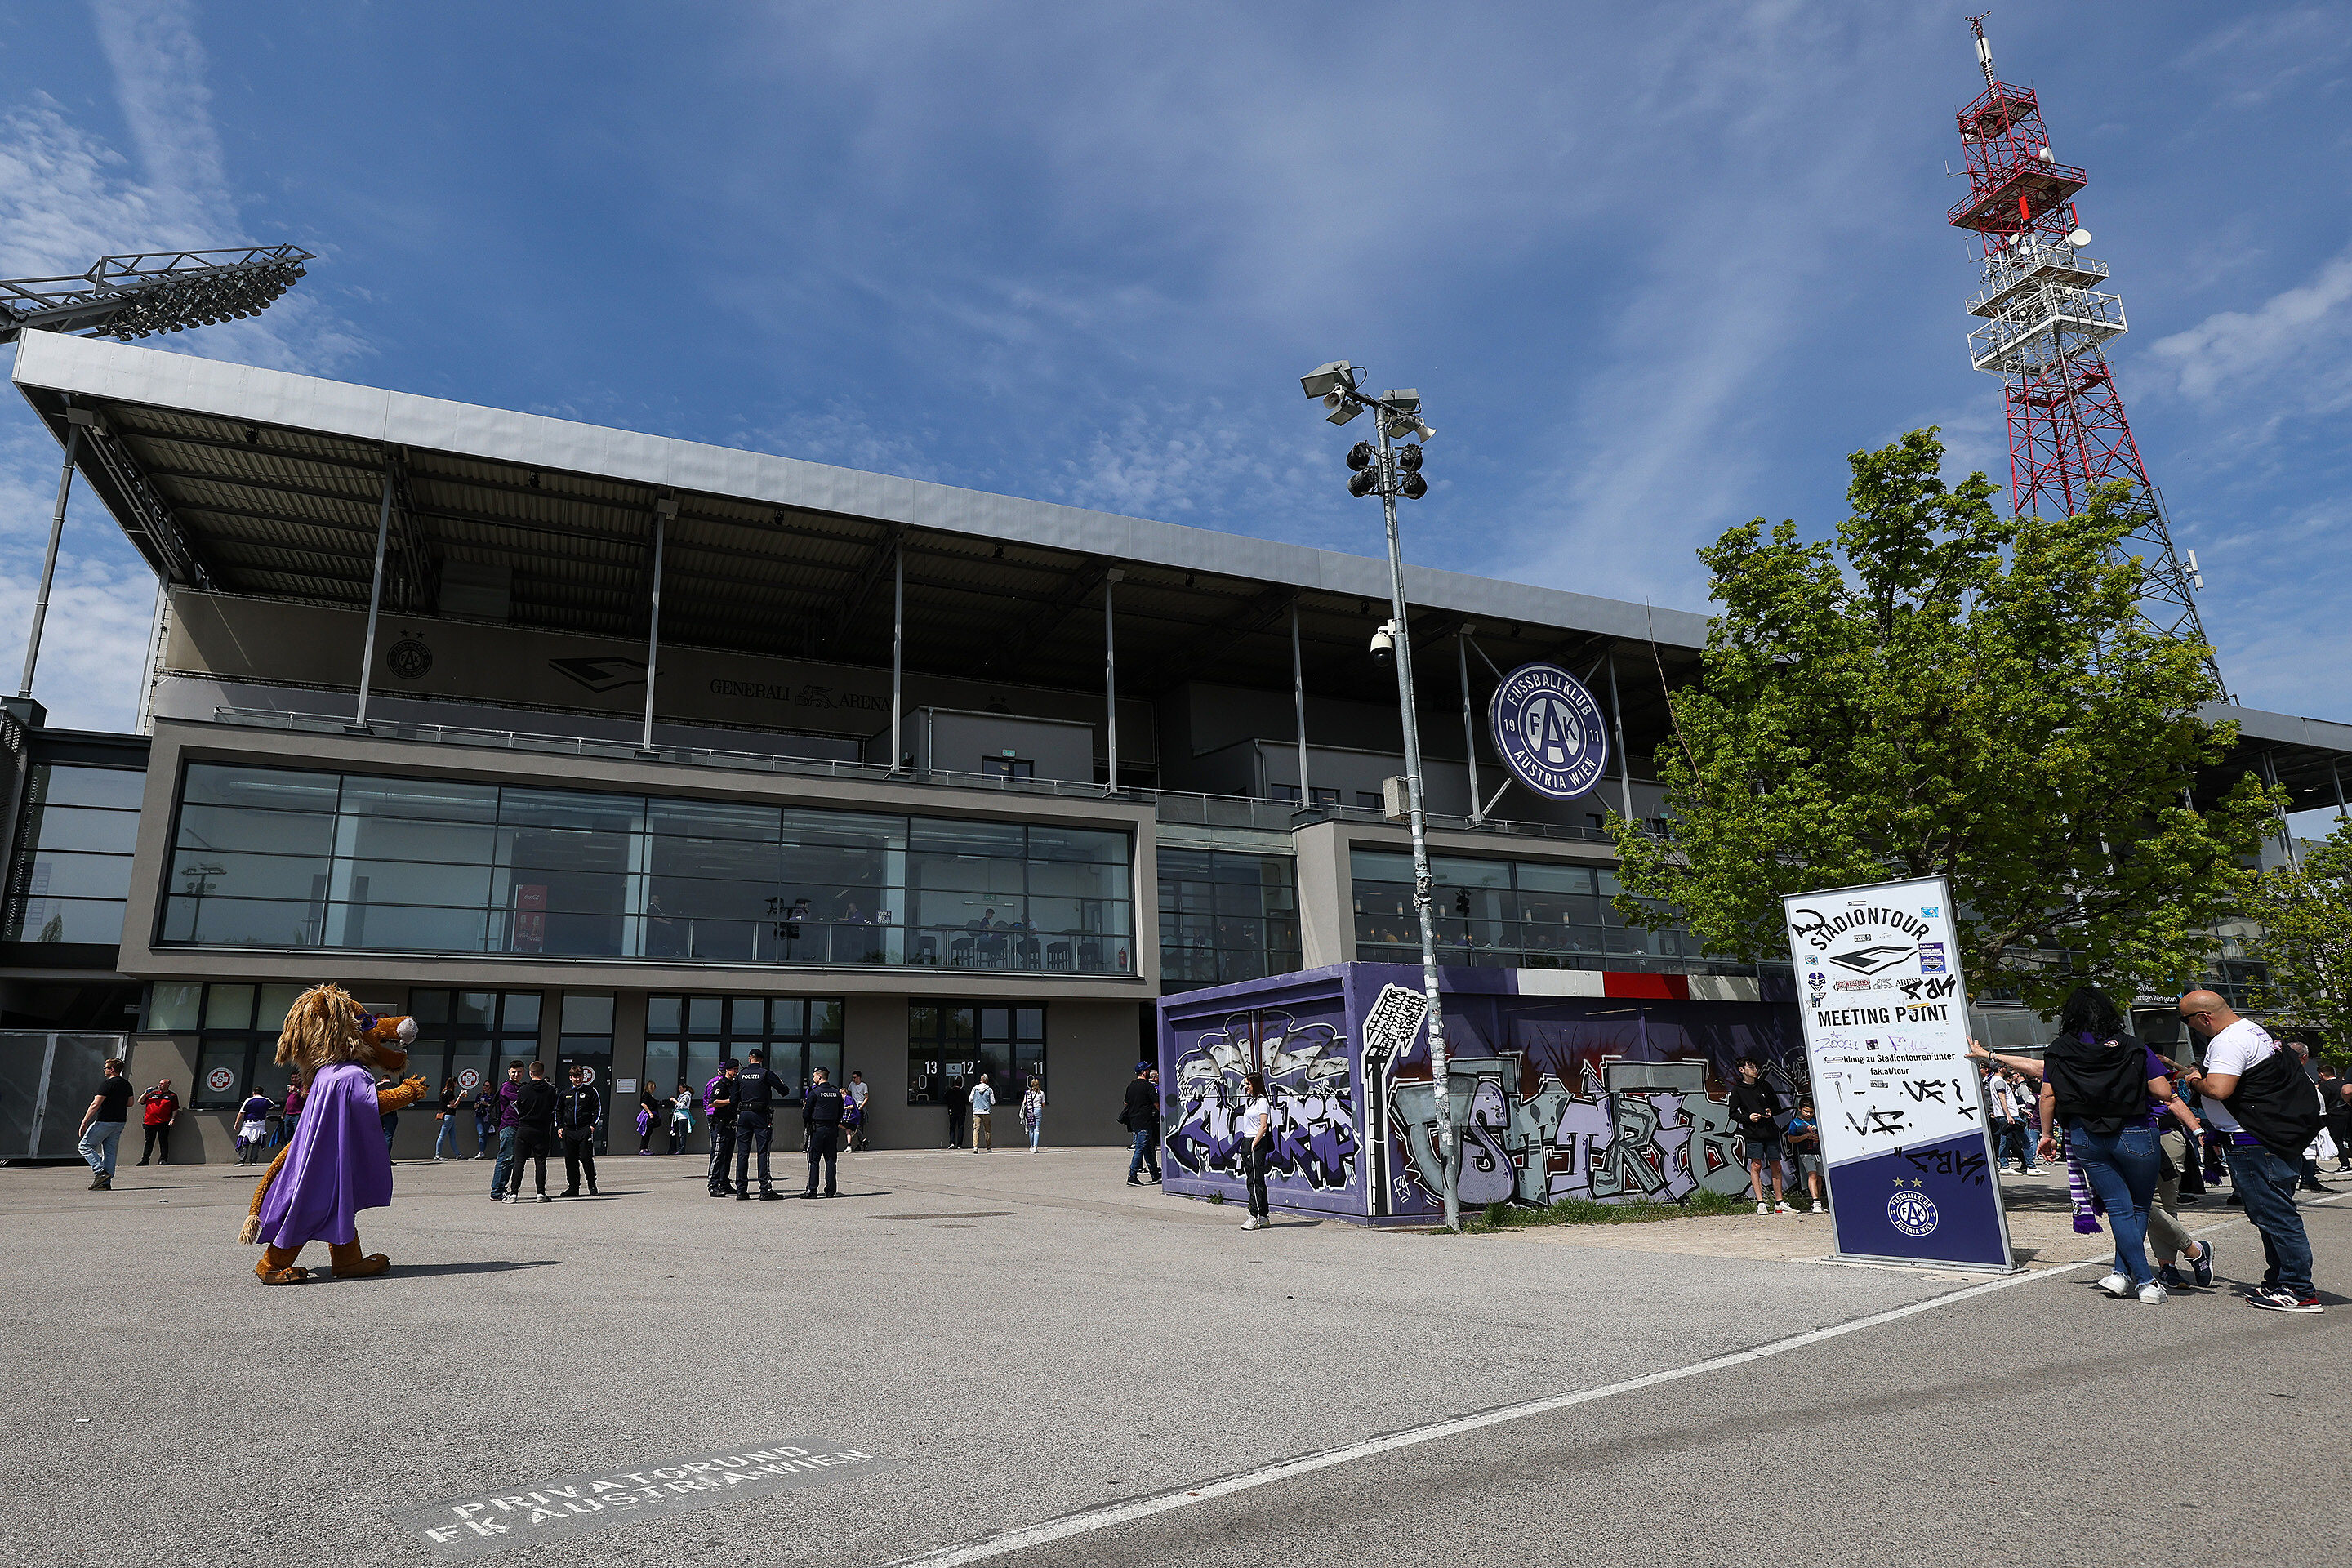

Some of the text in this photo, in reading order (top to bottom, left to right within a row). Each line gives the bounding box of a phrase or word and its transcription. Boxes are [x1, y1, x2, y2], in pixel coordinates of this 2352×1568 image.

[710, 679, 892, 711] GENERALI ARENA
[1506, 673, 1592, 715] FUSSBALLKLUB
[1503, 719, 1516, 732] 19
[1589, 729, 1600, 742] 11
[1514, 750, 1597, 789] AUSTRIA WIEN
[1810, 907, 1930, 951] STADIONTOUR
[1895, 978, 1921, 987] AREN
[1818, 1004, 1948, 1027] MEETING POINT
[1843, 1056, 1865, 1064] ldung
[1877, 1053, 1932, 1062] Stadiontouren
[1933, 1053, 1956, 1061] unter
[924, 1061, 938, 1075] 13
[961, 1061, 973, 1075] 12
[1033, 1061, 1043, 1075] 11
[1870, 1067, 1909, 1076] fak.at/tour
[1891, 1193, 1931, 1208] FUSSBALLKLUB
[1895, 1220, 1934, 1235] AUSTRIA WIEN
[450, 1446, 810, 1520] PRIVATGRUND
[425, 1450, 875, 1544] FK AUSTRIA WIEN
